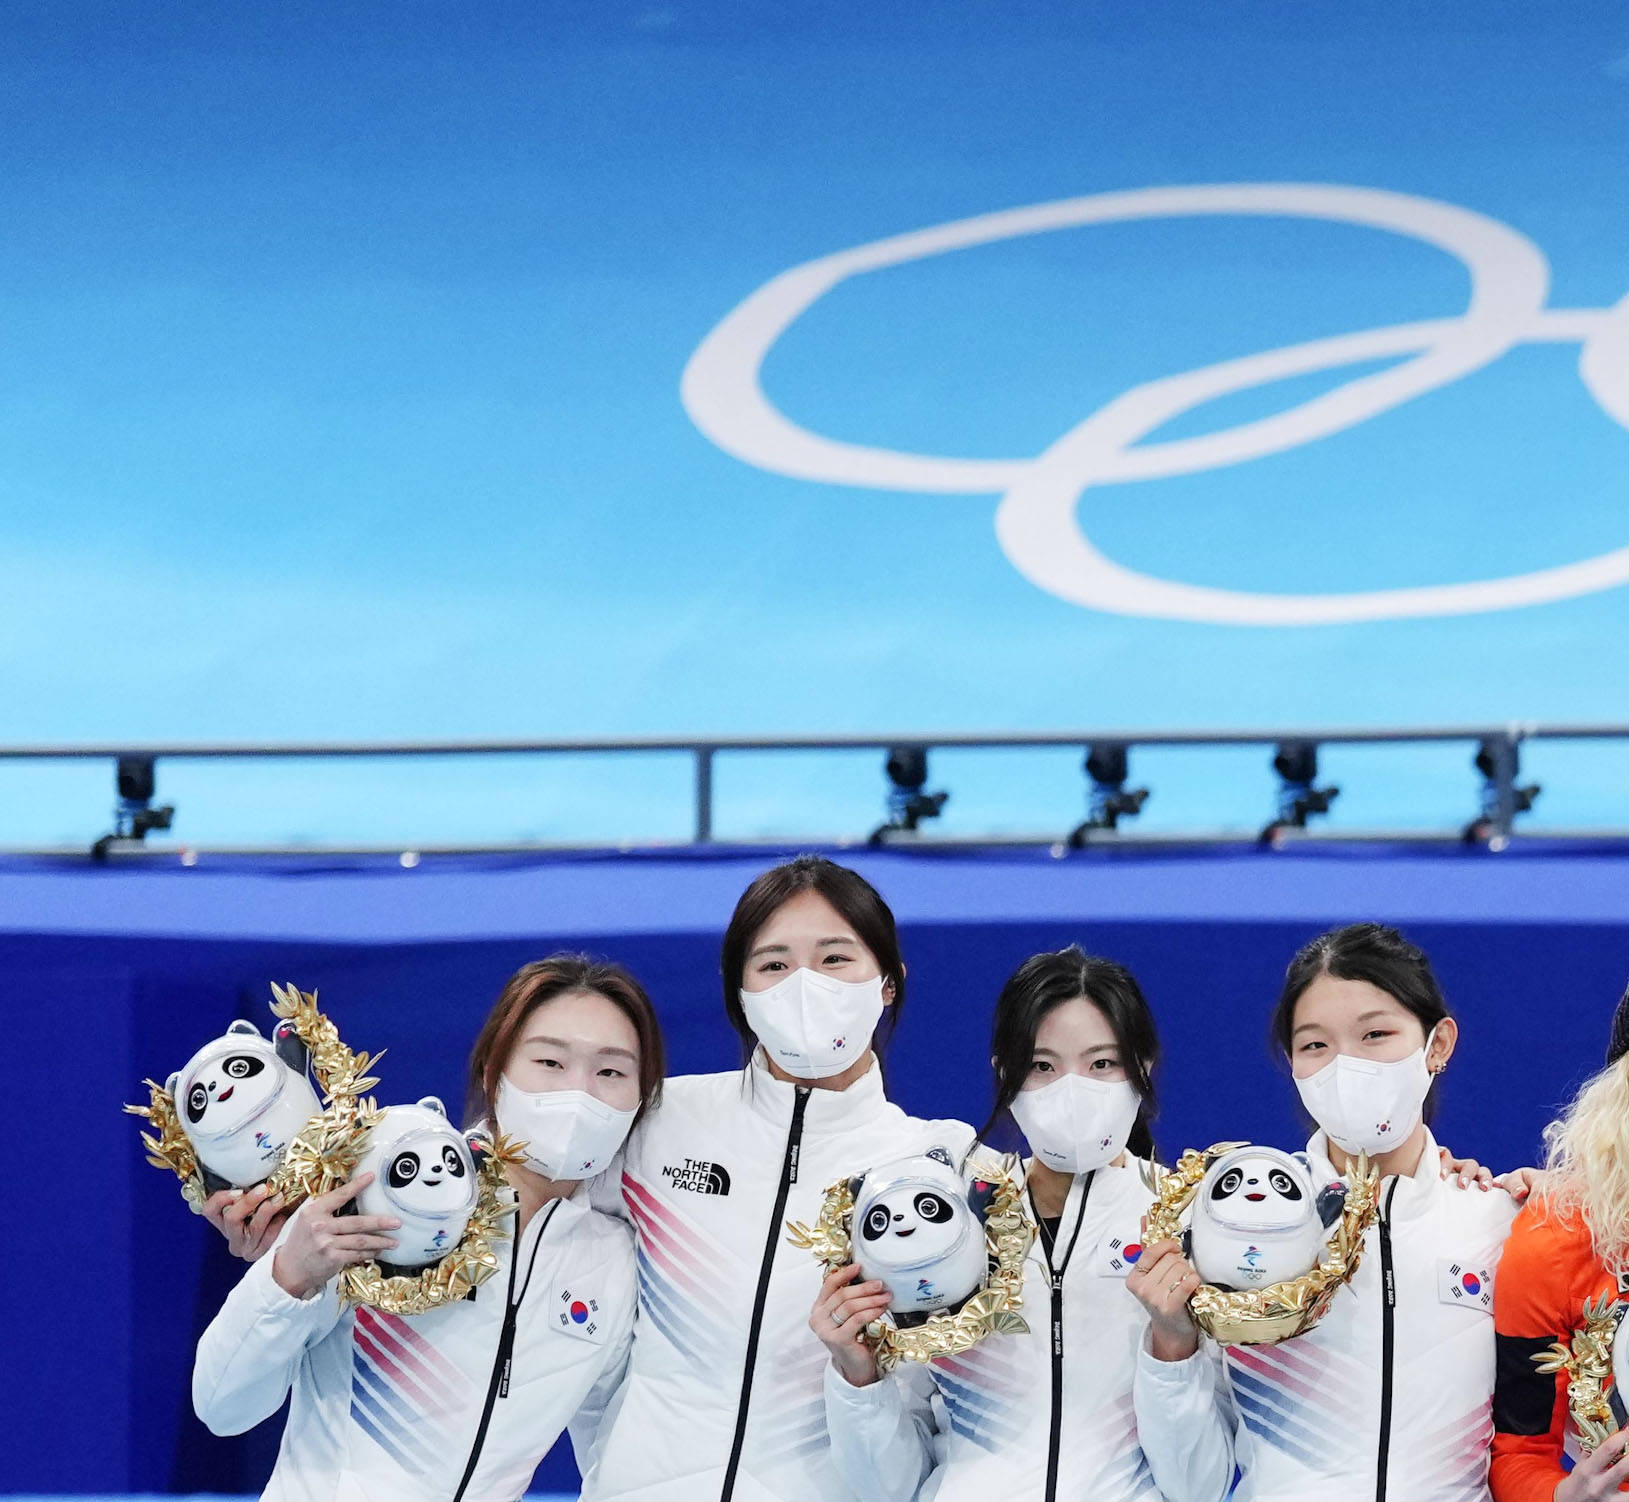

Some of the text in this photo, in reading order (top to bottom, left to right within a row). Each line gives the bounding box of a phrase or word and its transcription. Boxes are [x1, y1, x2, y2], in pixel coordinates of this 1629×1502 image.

[684, 1158, 711, 1173] THE
[662, 1165, 709, 1183] NORTH
[671, 1179, 706, 1194] FACE
